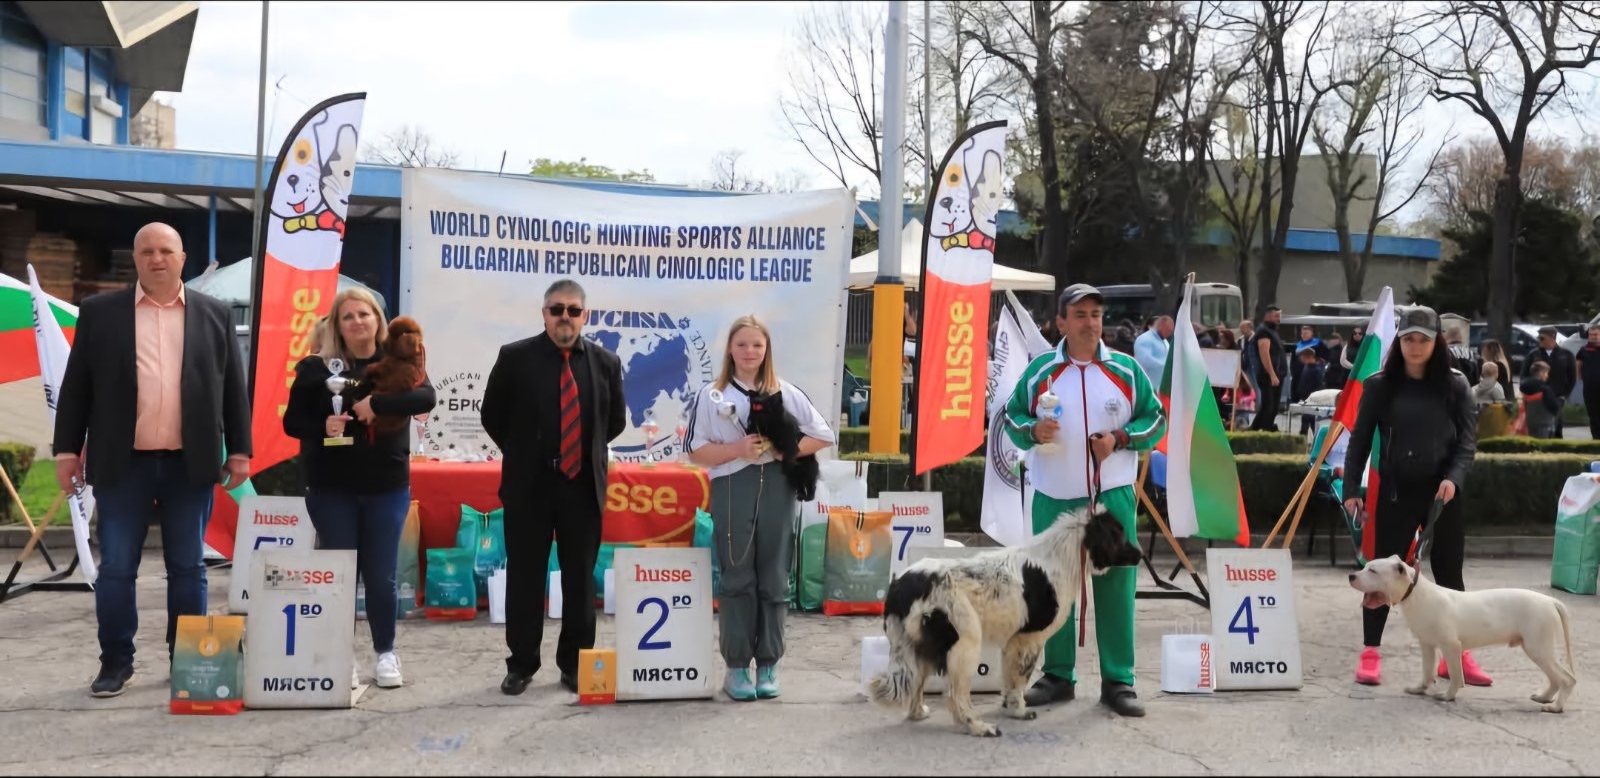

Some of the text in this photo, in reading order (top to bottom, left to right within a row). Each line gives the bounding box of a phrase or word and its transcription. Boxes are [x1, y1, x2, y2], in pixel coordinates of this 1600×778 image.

[430, 209, 826, 251] WORLD CYNOLOGIC HUNTING SPORTS ALLIANCE
[441, 243, 812, 283] BULGARIAN REPUBLICAN CINOLOGIC LEAGUE
[277, 288, 320, 417] sse
[940, 301, 974, 421] husse
[435, 372, 481, 391] UBLICAN
[448, 398, 482, 412] БРК
[606, 482, 678, 515] sse
[253, 510, 299, 526] husse
[892, 503, 930, 516] husse
[287, 570, 335, 585] sse
[634, 564, 692, 582] husse
[1225, 564, 1277, 581] husse
[1197, 642, 1211, 689] husse
[1230, 661, 1288, 675] МЯСТО
[632, 667, 699, 682] МЯСТО
[263, 677, 334, 692] МЯСТО
